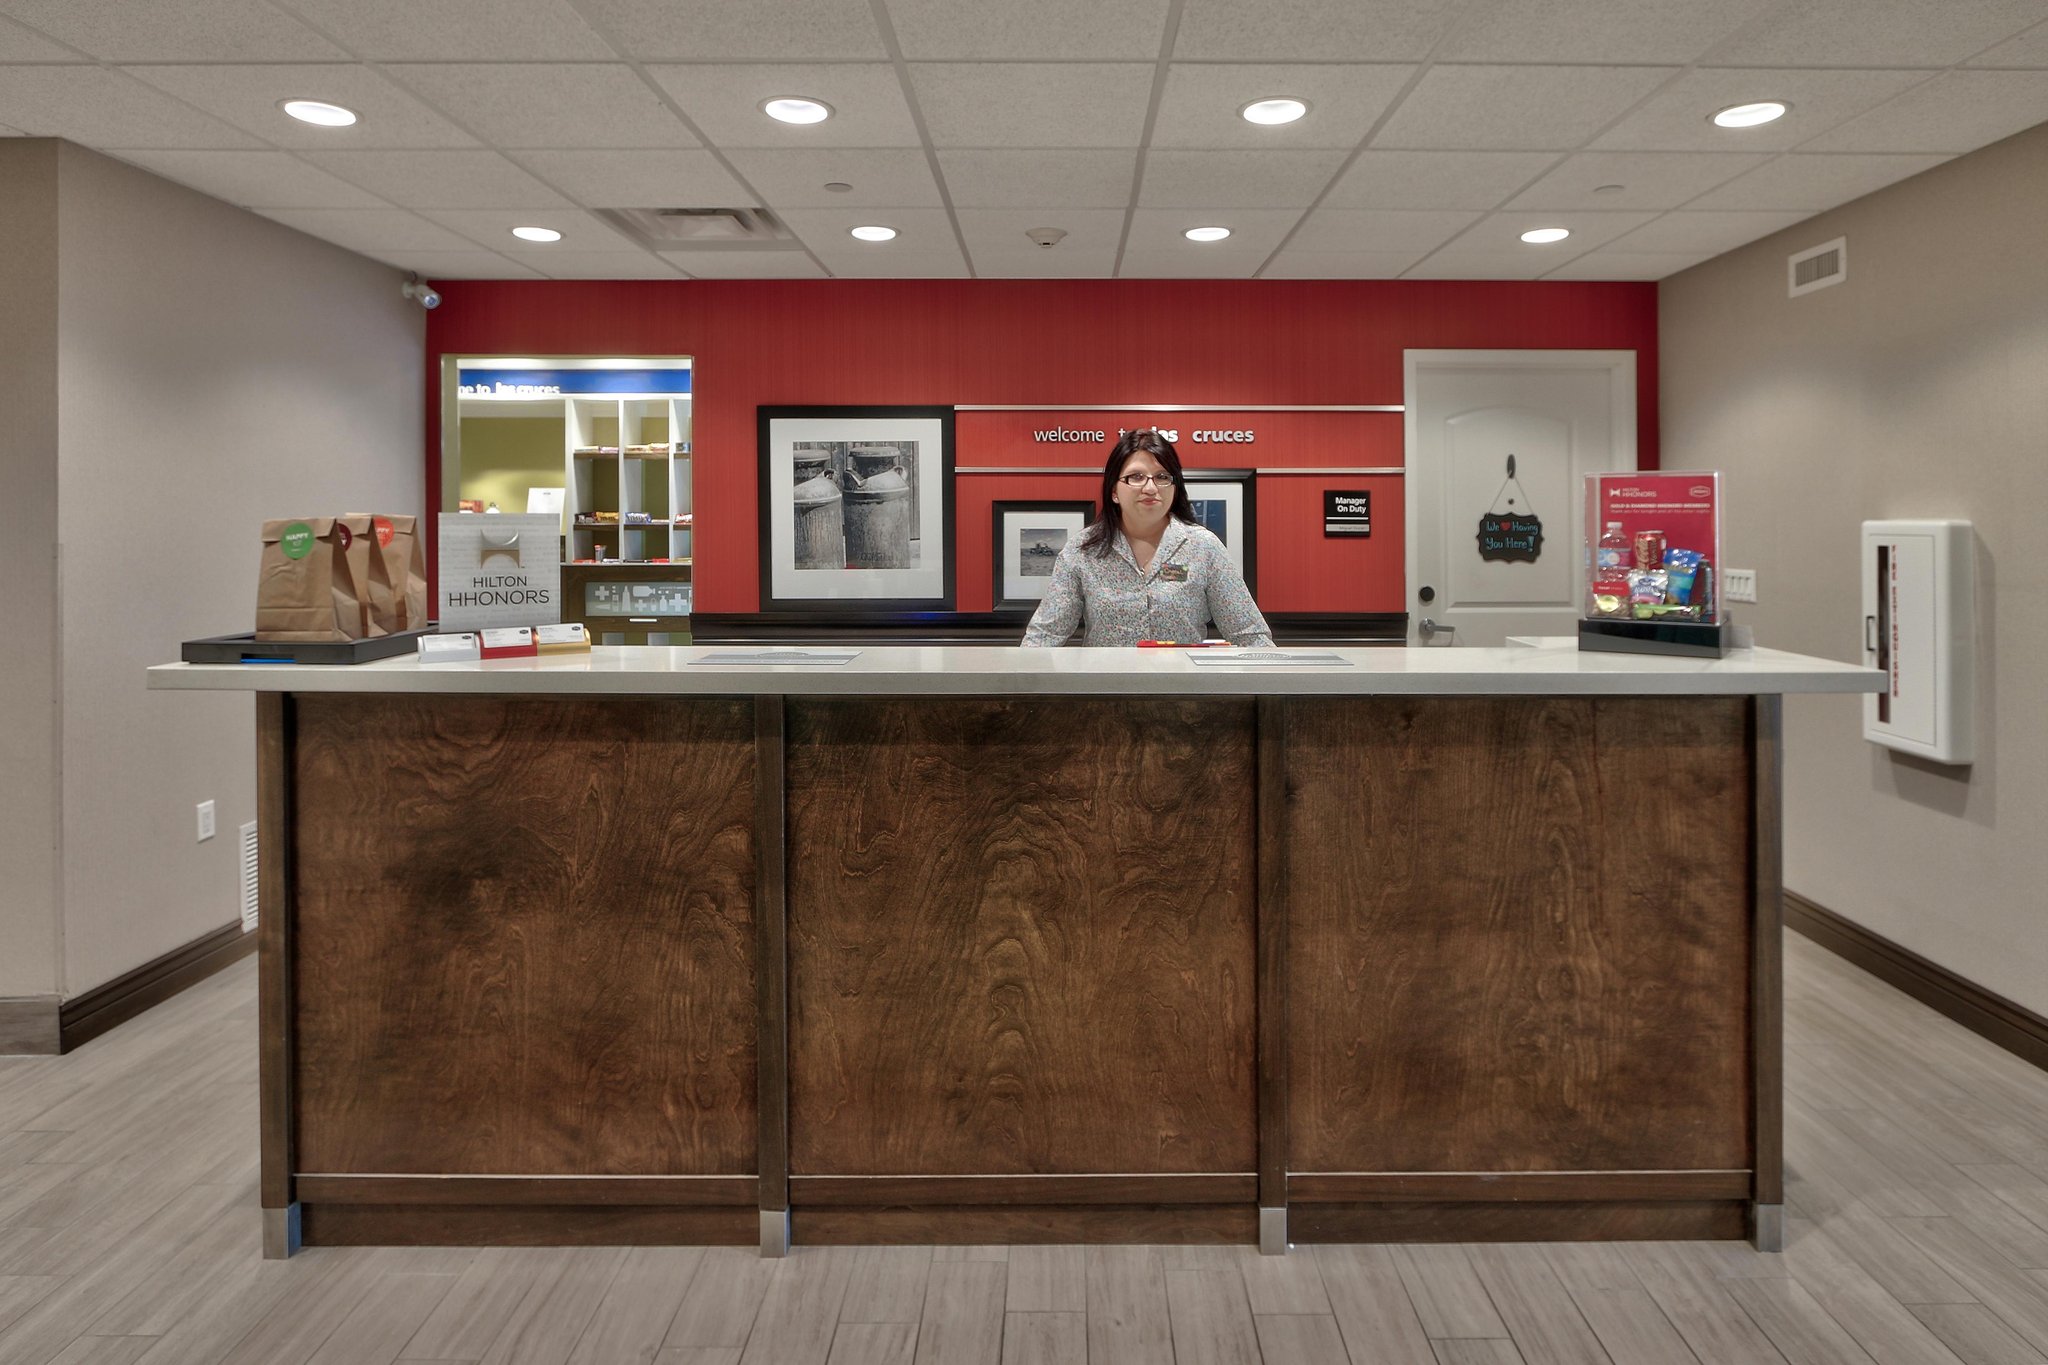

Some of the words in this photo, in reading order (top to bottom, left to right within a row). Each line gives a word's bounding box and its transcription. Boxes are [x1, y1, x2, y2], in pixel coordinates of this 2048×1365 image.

[1034, 426, 1105, 442] welcome
[1192, 429, 1255, 443] cruces
[1335, 496, 1367, 506] Manager
[1337, 505, 1348, 513] On
[1349, 505, 1367, 514] Duty
[1486, 521, 1500, 531] We
[1512, 521, 1539, 536] Having
[1485, 537, 1504, 551] You
[473, 576, 527, 588] HILTON
[449, 589, 550, 607] HHONORS
